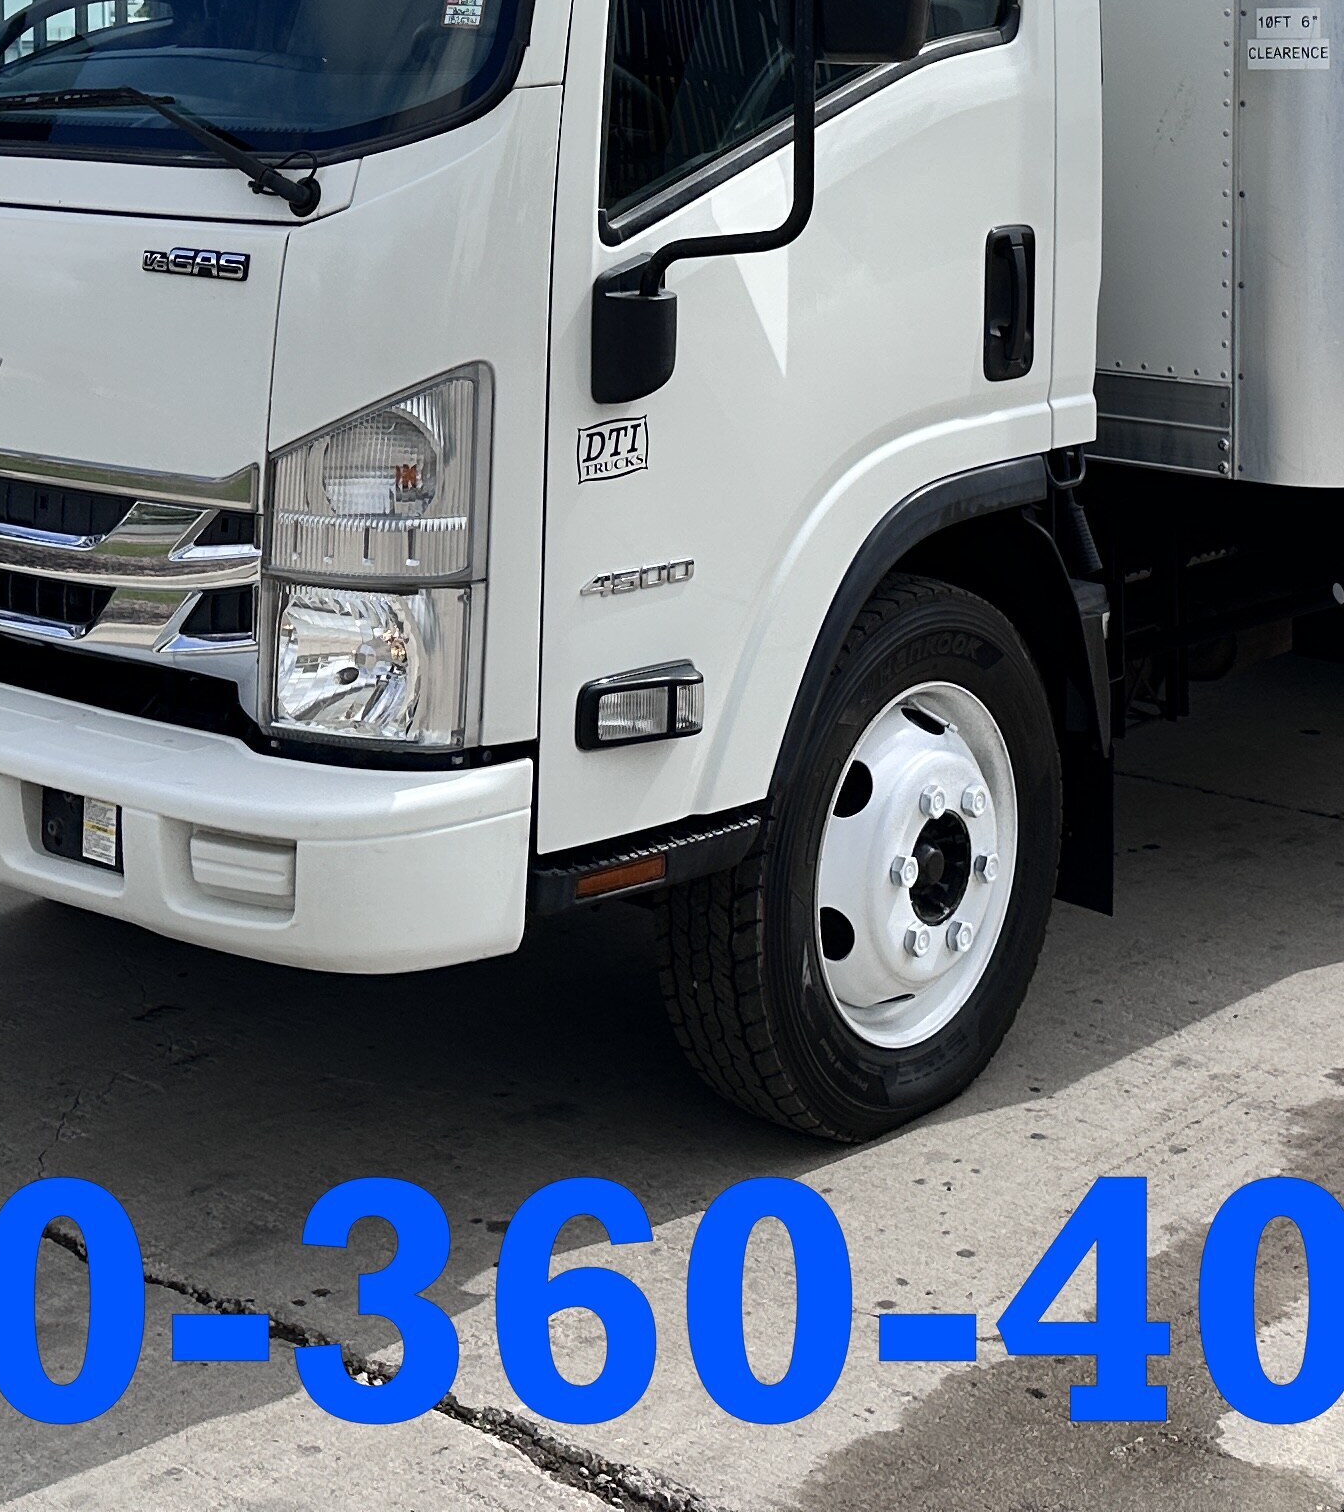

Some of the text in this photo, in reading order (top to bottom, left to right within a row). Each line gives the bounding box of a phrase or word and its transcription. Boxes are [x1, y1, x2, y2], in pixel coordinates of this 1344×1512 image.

[1248, 46, 1329, 60] CLEARENCE
[168, 249, 246, 280] GAS
[582, 423, 642, 464] DTI
[584, 453, 644, 477] TRUCKS
[579, 556, 696, 598] 4500
